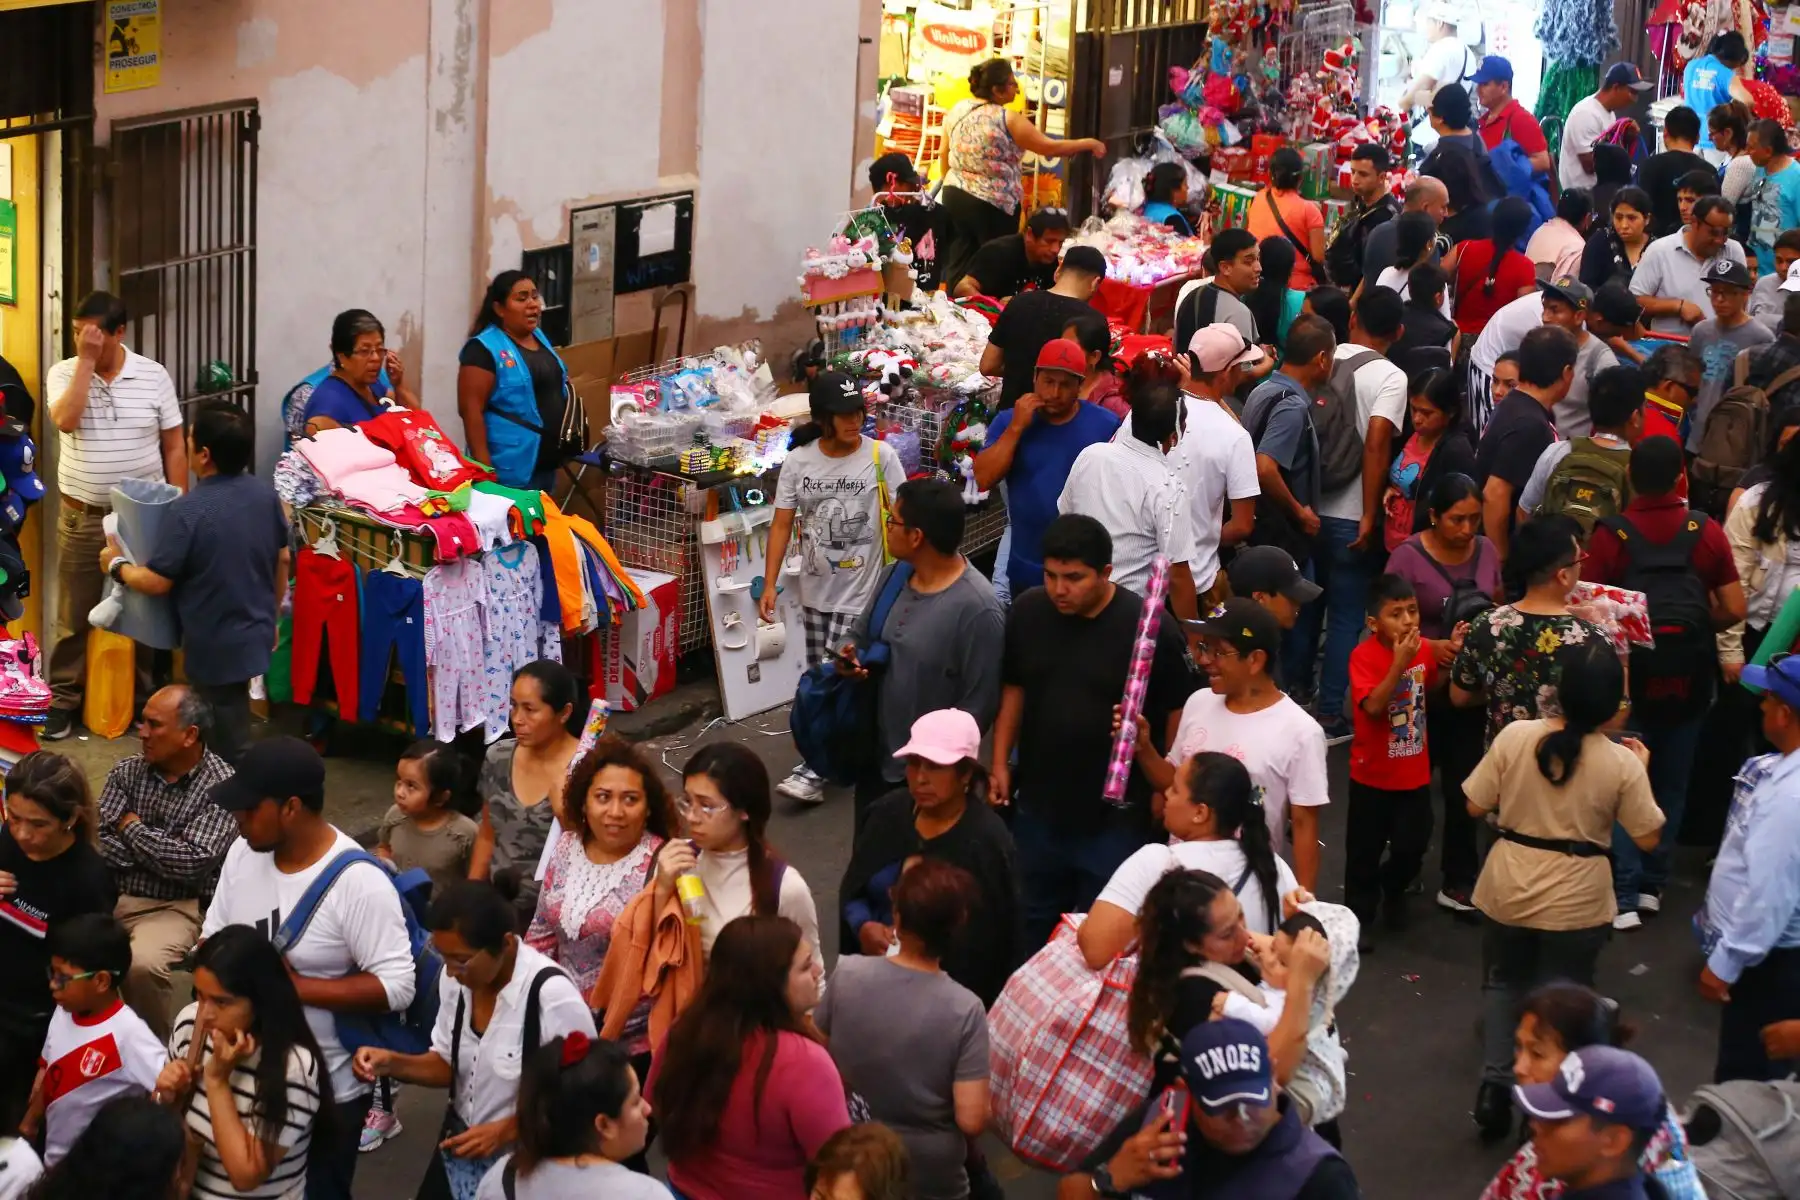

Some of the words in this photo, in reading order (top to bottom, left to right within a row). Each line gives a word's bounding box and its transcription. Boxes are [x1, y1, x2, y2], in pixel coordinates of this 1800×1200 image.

[110, 54, 157, 69] PROSEGUR
[843, 390, 859, 398] adidas
[1575, 487, 1596, 502] CAT
[1193, 1042, 1261, 1080] UNOES
